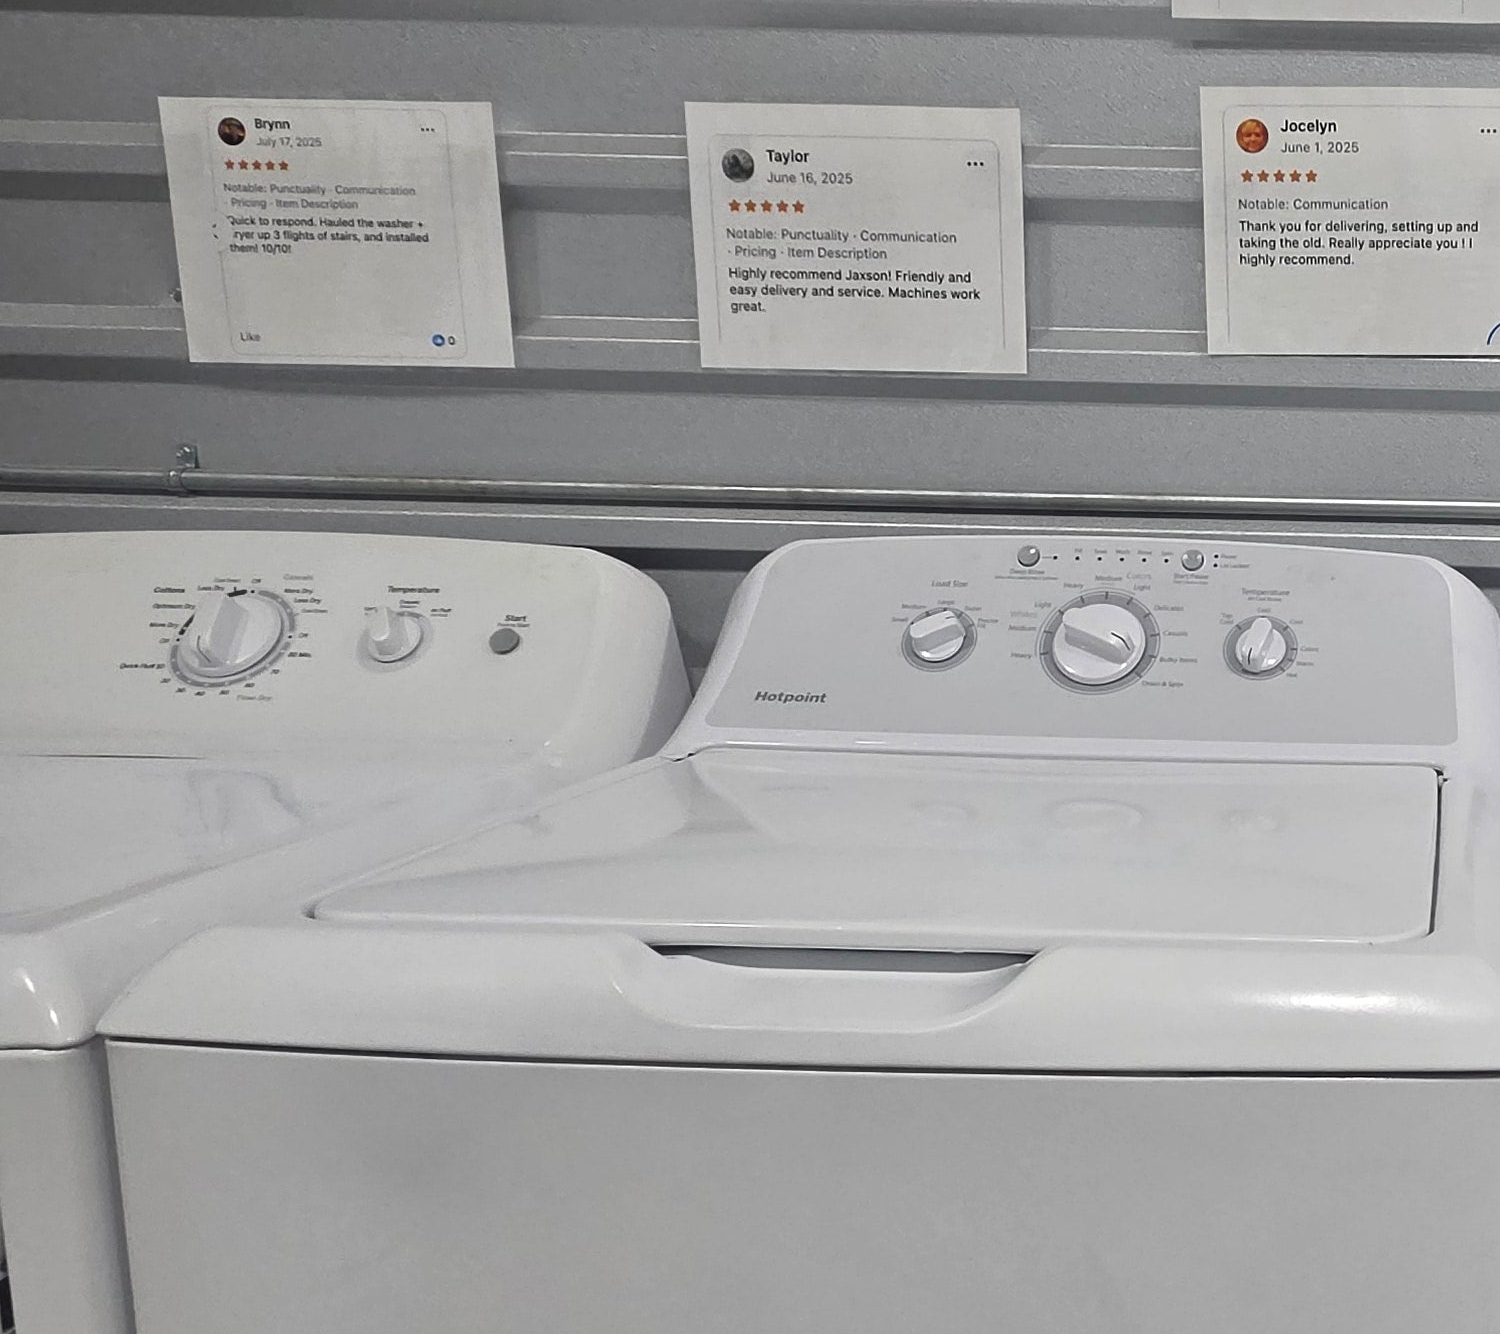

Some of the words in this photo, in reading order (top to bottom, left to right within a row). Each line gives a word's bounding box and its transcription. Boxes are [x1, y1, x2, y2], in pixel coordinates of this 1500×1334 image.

[254, 117, 291, 132] Brynn
[1280, 118, 1337, 135] Jocelyn
[1280, 141, 1310, 153] June
[1314, 141, 1323, 155] 1,
[765, 149, 810, 166] Taylor
[766, 171, 797, 183] June
[799, 171, 817, 186] 16,
[1238, 197, 1289, 210] Notable:
[1293, 197, 1388, 210] Communication
[1238, 219, 1276, 232] Thank
[1278, 222, 1301, 234] you
[1304, 219, 1322, 232] for
[1325, 219, 1387, 234] delivering,
[1391, 219, 1433, 235] setting
[1437, 222, 1453, 234] up
[1455, 220, 1478, 232] and
[1239, 236, 1276, 251] taking
[1279, 236, 1299, 249] the
[1302, 236, 1325, 249] old.
[1328, 236, 1365, 251] Really
[1368, 236, 1432, 251] appreciate
[1435, 239, 1458, 251] you
[1239, 253, 1276, 267] highly
[1279, 253, 1354, 265] recommend.
[728, 266, 767, 282] Highly
[769, 268, 842, 281] recommend
[845, 269, 892, 282] Jaxson!
[895, 269, 945, 285] Friendly
[947, 271, 971, 283] and
[754, 691, 827, 704] Hotpoint
